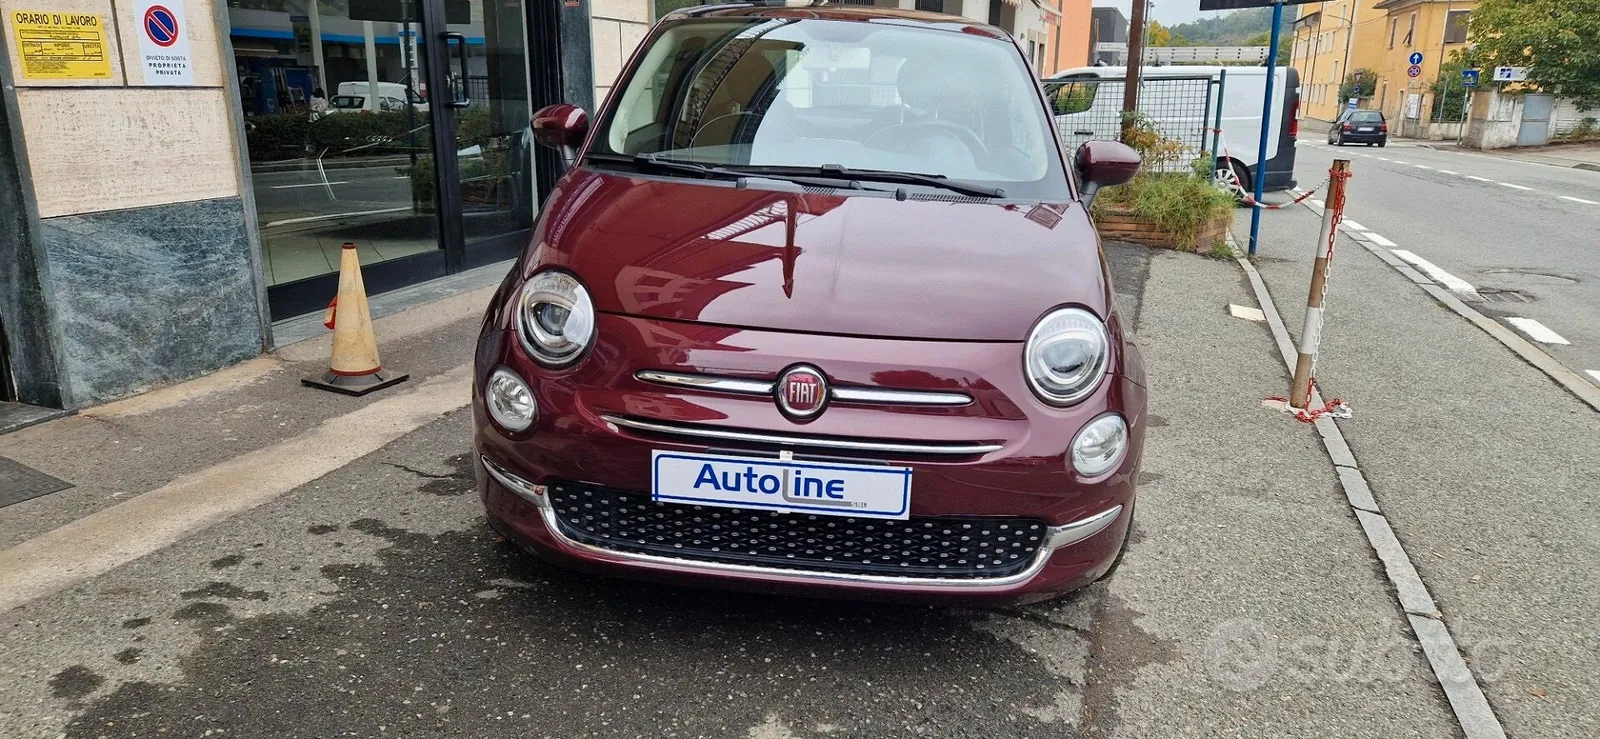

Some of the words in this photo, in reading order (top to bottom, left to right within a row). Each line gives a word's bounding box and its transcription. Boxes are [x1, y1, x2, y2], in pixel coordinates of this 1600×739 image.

[16, 12, 50, 25] ORARIO
[53, 14, 62, 25] DI
[65, 15, 97, 27] LAVORO
[789, 381, 817, 405] FIAT
